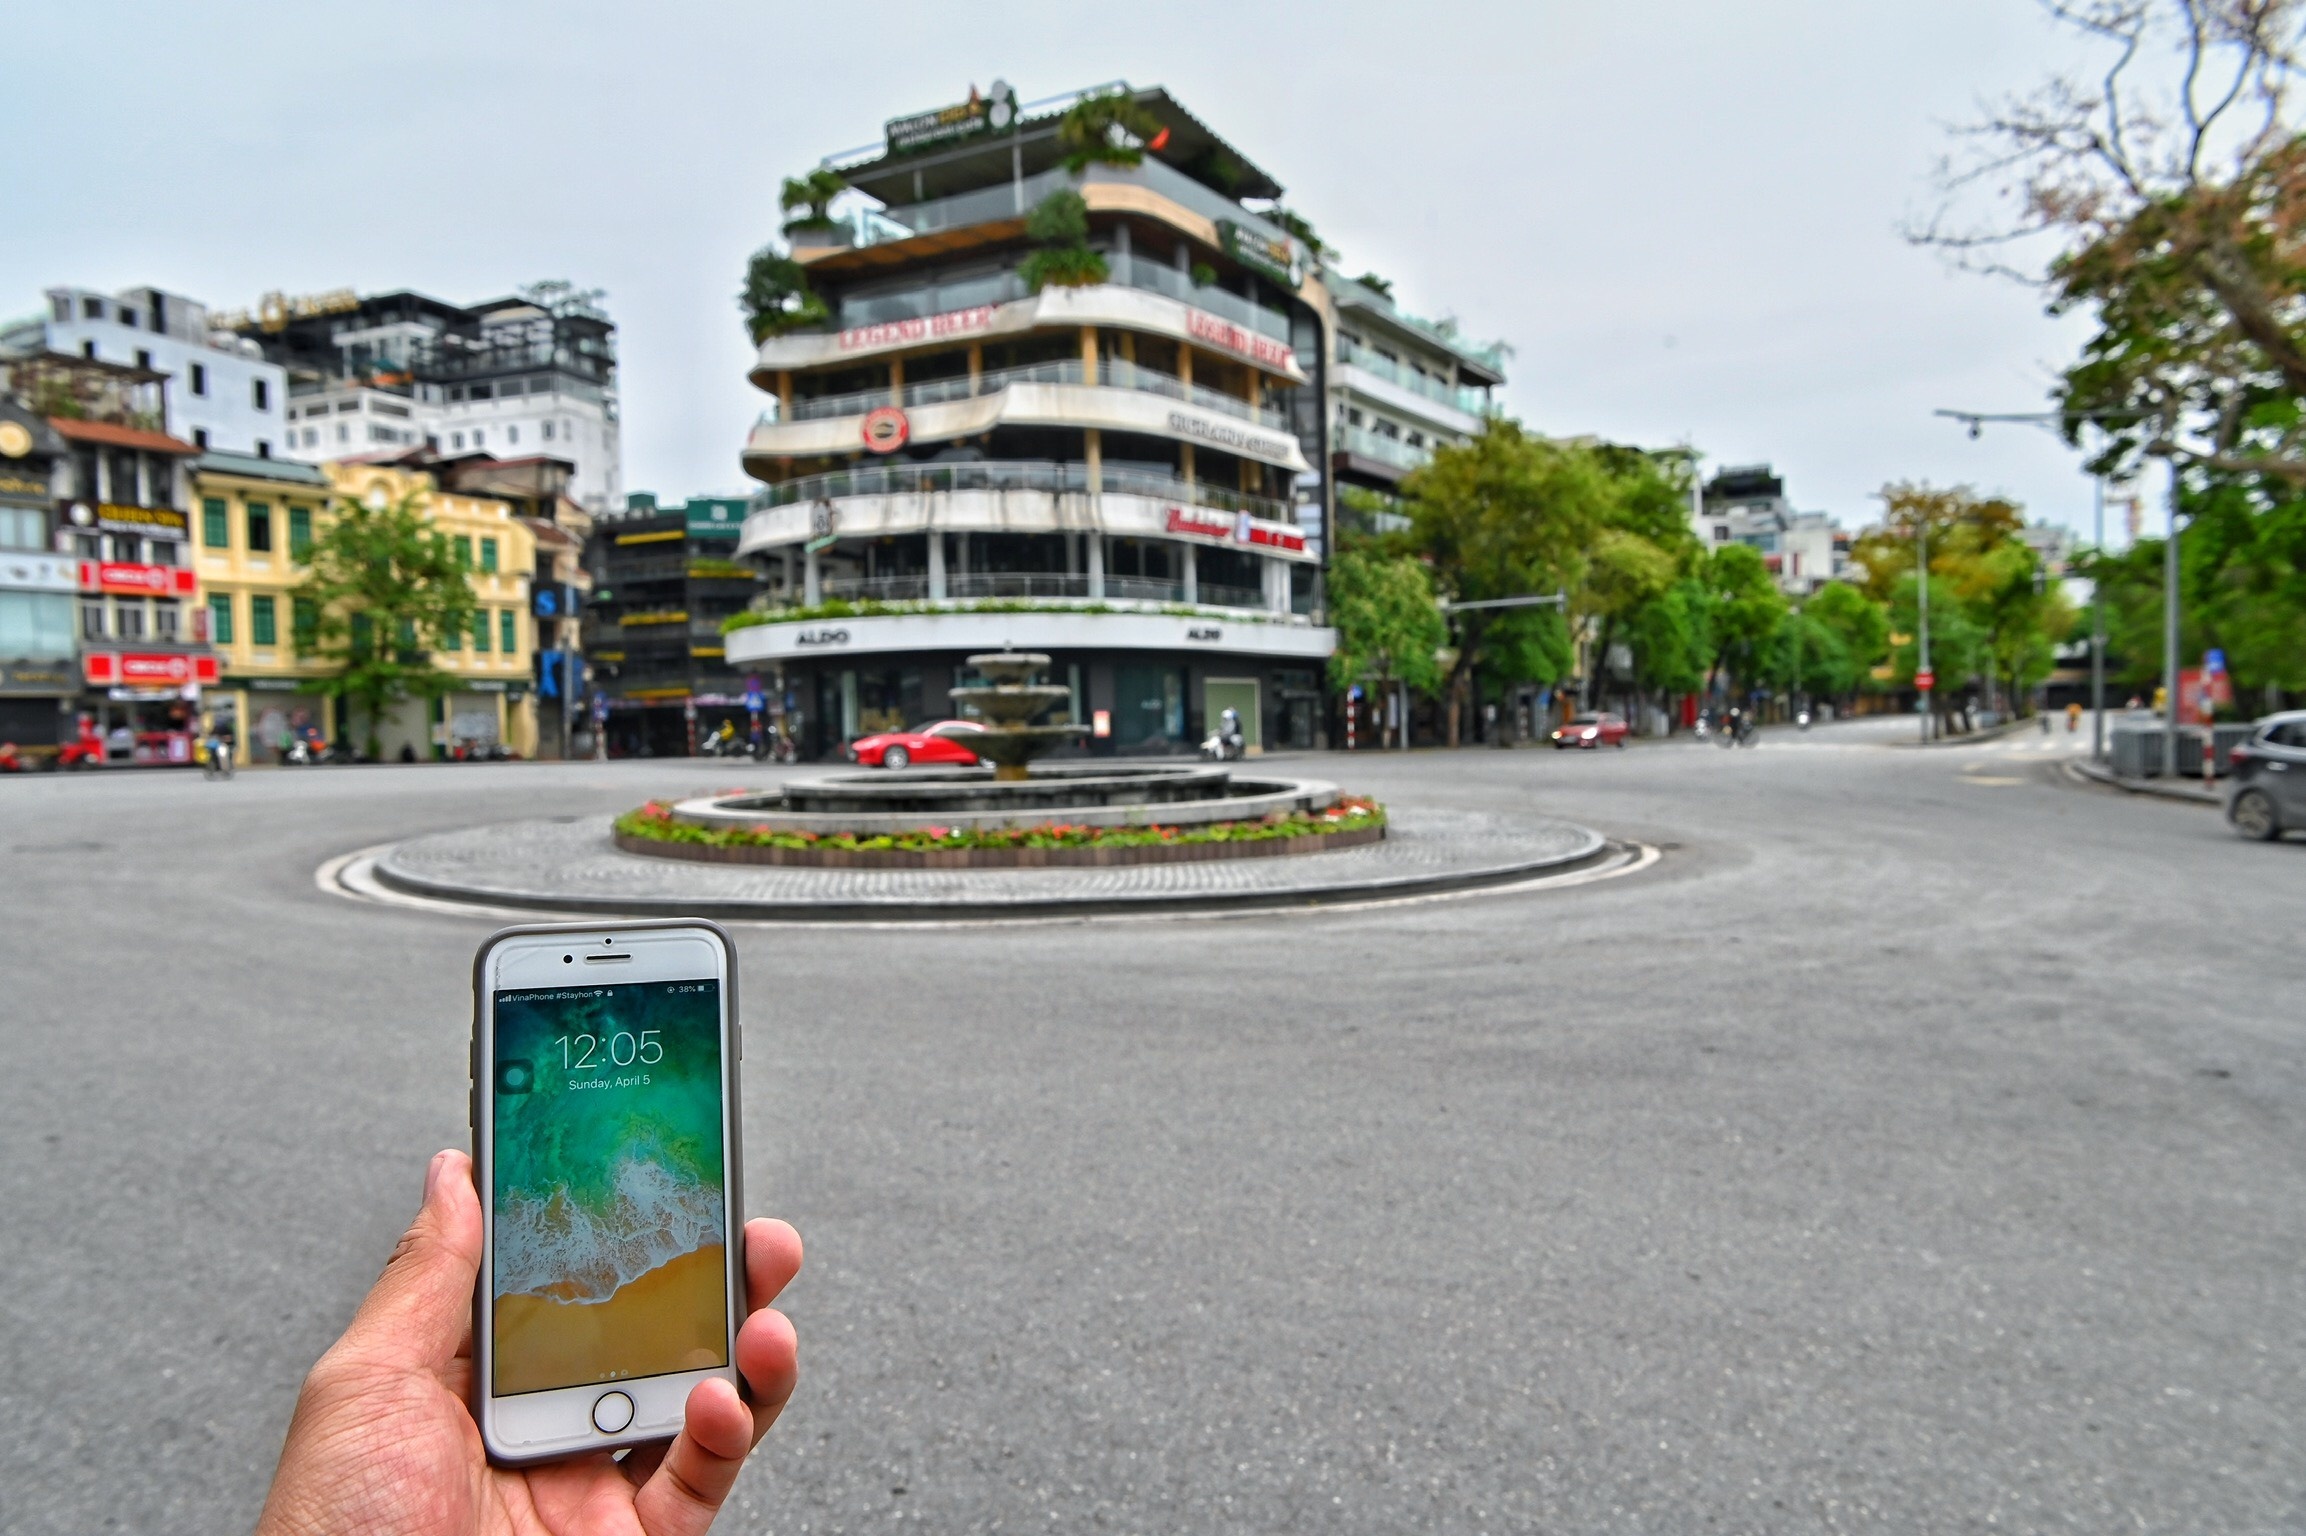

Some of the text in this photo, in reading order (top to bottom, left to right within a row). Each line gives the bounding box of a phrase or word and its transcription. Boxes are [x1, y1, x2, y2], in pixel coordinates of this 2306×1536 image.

[839, 304, 992, 349] LEGEND BEER
[796, 629, 850, 646] ALDO
[1187, 628, 1223, 641] ALDO
[512, 991, 593, 1002] VinaPhone #Stayhon
[679, 985, 696, 993] 38%
[554, 1029, 663, 1070] 12:05
[568, 1074, 651, 1091] Sunday, April 5
